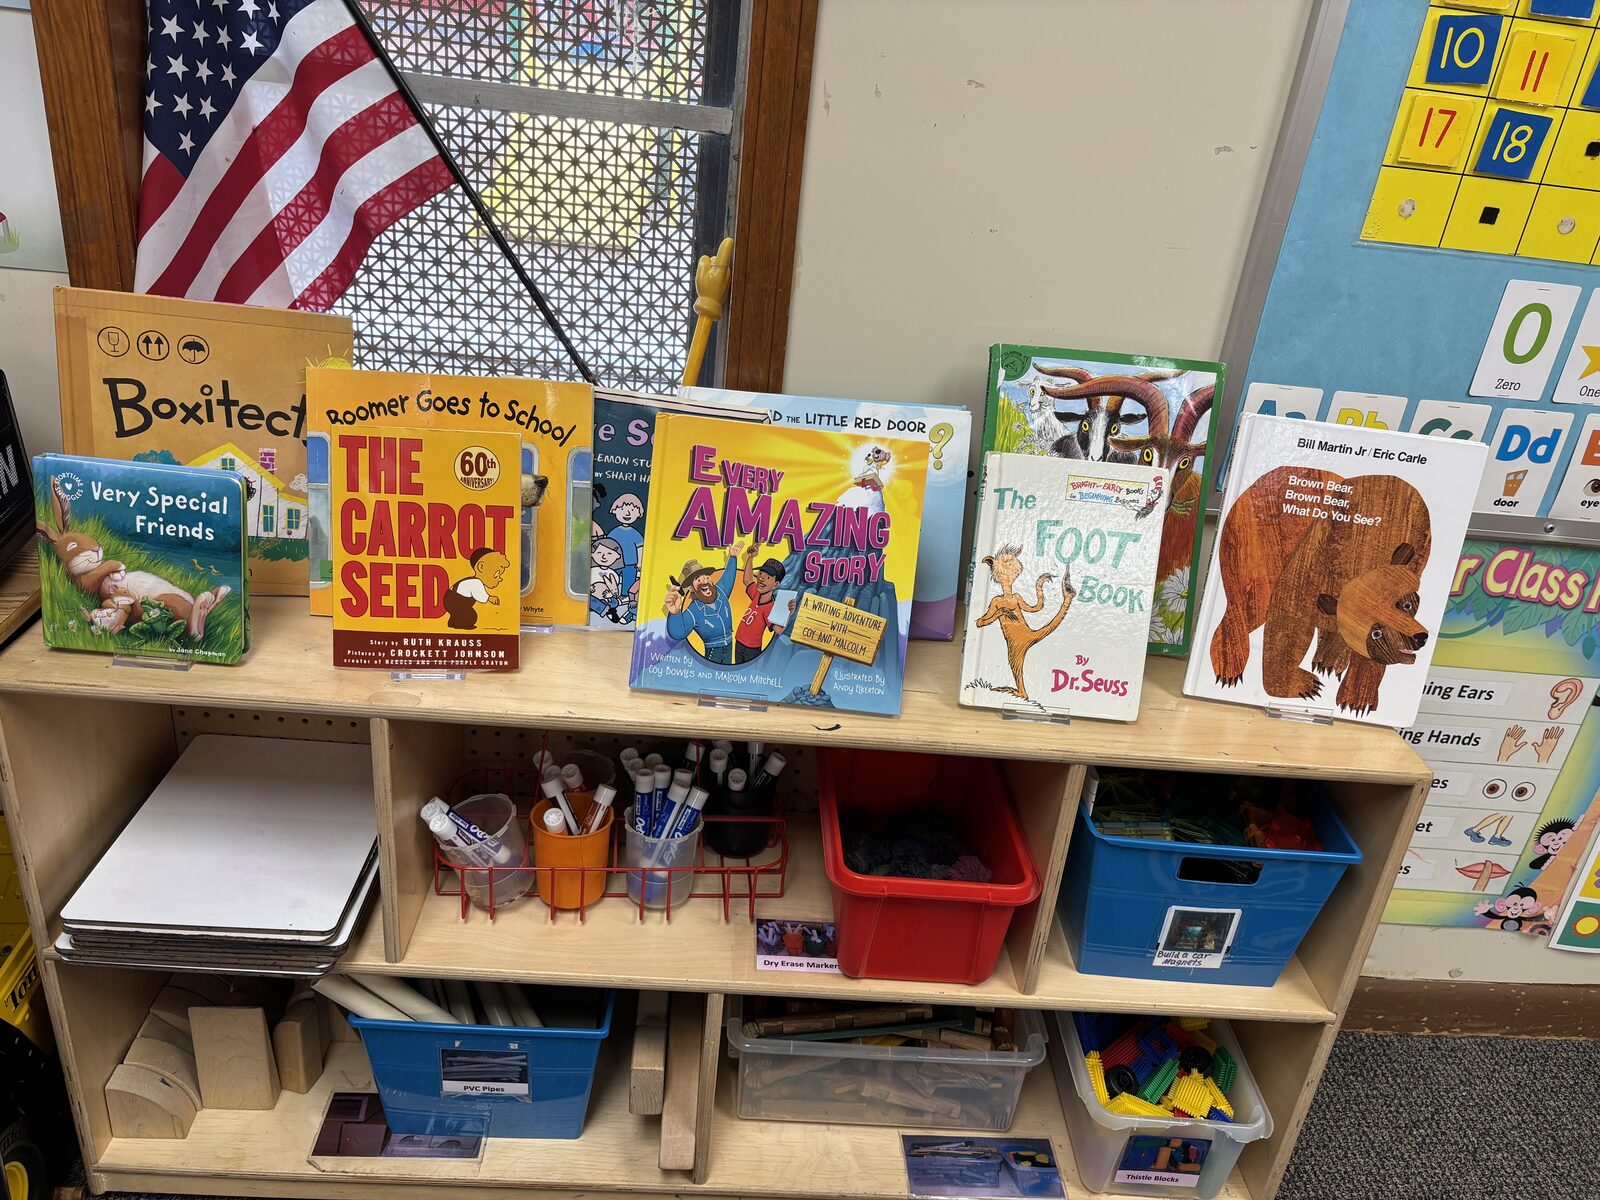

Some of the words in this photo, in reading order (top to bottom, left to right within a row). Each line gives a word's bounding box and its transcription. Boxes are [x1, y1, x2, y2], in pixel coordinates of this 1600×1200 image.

[1441, 26, 1485, 69] 10
[1520, 49, 1549, 93] 11
[1419, 107, 1457, 149] 17
[1492, 121, 1533, 164] 18
[1503, 302, 1552, 365] 0
[1494, 379, 1521, 392] Zero
[1579, 385, 1600, 397] One
[326, 394, 409, 425] Roomer
[416, 390, 471, 416] Goes
[479, 391, 500, 418] to
[504, 400, 577, 447] School
[805, 413, 848, 427] LITTLE
[854, 417, 881, 429] RED
[887, 420, 926, 433] DOOR
[1297, 438, 1315, 449] Bill
[1318, 440, 1352, 455] Martin
[1355, 446, 1367, 457] Jr
[1373, 448, 1395, 461] Eric
[1398, 451, 1427, 465] Carle
[1495, 424, 1563, 464] Dd
[339, 435, 423, 496] THE
[460, 451, 496, 477] 60th
[605, 470, 636, 482] SHARI
[1288, 475, 1324, 489] Brown
[1327, 480, 1353, 494] Bear,
[91, 481, 140, 507] Very
[146, 487, 228, 515] Special
[993, 487, 1037, 511] The
[1285, 489, 1320, 504] Brown
[1323, 495, 1350, 509] Bear,
[1493, 497, 1519, 508] door
[1580, 499, 1600, 508] eye
[671, 486, 892, 552] AMAZING
[1282, 503, 1310, 517] What
[1312, 508, 1328, 519] Do
[1331, 511, 1350, 523] You
[1353, 513, 1381, 527] See?
[136, 515, 215, 541] Friends
[341, 498, 514, 560] CARROT
[1035, 519, 1142, 570] FOOT
[802, 551, 887, 587] STORY
[1485, 548, 1587, 607] Class
[341, 561, 450, 618] SEED
[1076, 574, 1144, 614] BOOK
[742, 607, 757, 625] 26
[803, 598, 808, 608] A
[812, 600, 841, 618] WRITING
[843, 610, 883, 631] ADVENTURE
[830, 620, 848, 635] WITH
[390, 649, 448, 658] CROCKETT
[454, 650, 505, 658] JOHNSON
[403, 638, 431, 647] RUTH
[438, 638, 482, 647] KRAUSS
[802, 627, 816, 640] COY
[818, 631, 832, 644] AND
[834, 637, 867, 656] MALCOLM
[1075, 655, 1089, 667] By
[1457, 684, 1494, 700] Ears
[1427, 730, 1481, 746] Hands
[763, 959, 779, 967] Dry
[781, 960, 804, 968] Erase
[1157, 950, 1180, 959] Build
[1162, 958, 1202, 966] Magnets
[482, 1085, 505, 1093] Pipes
[1127, 1173, 1153, 1181] Thistle
[1154, 1175, 1180, 1183] Blocks
